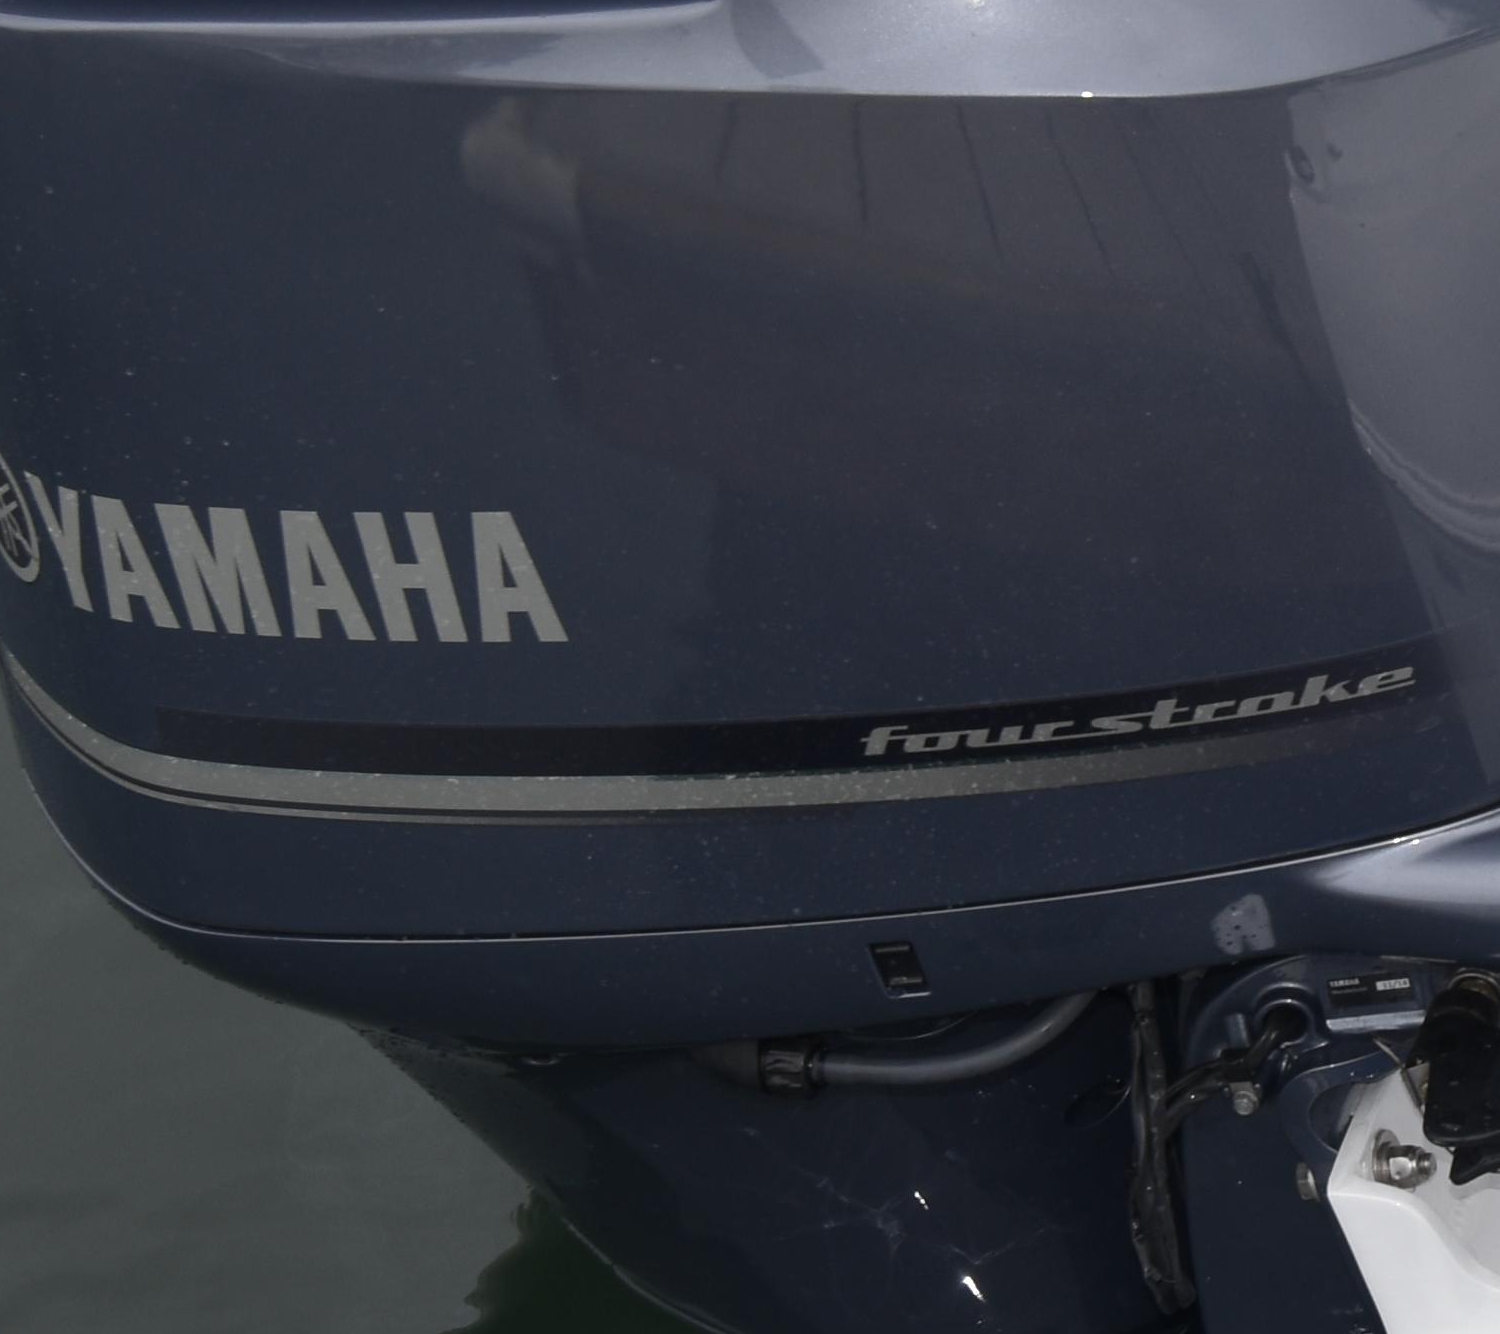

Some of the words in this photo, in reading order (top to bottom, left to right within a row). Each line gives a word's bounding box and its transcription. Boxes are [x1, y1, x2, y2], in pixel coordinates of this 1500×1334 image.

[23, 470, 569, 643] YAMAHA
[860, 720, 1074, 756] four
[1091, 667, 1416, 736] stroke
